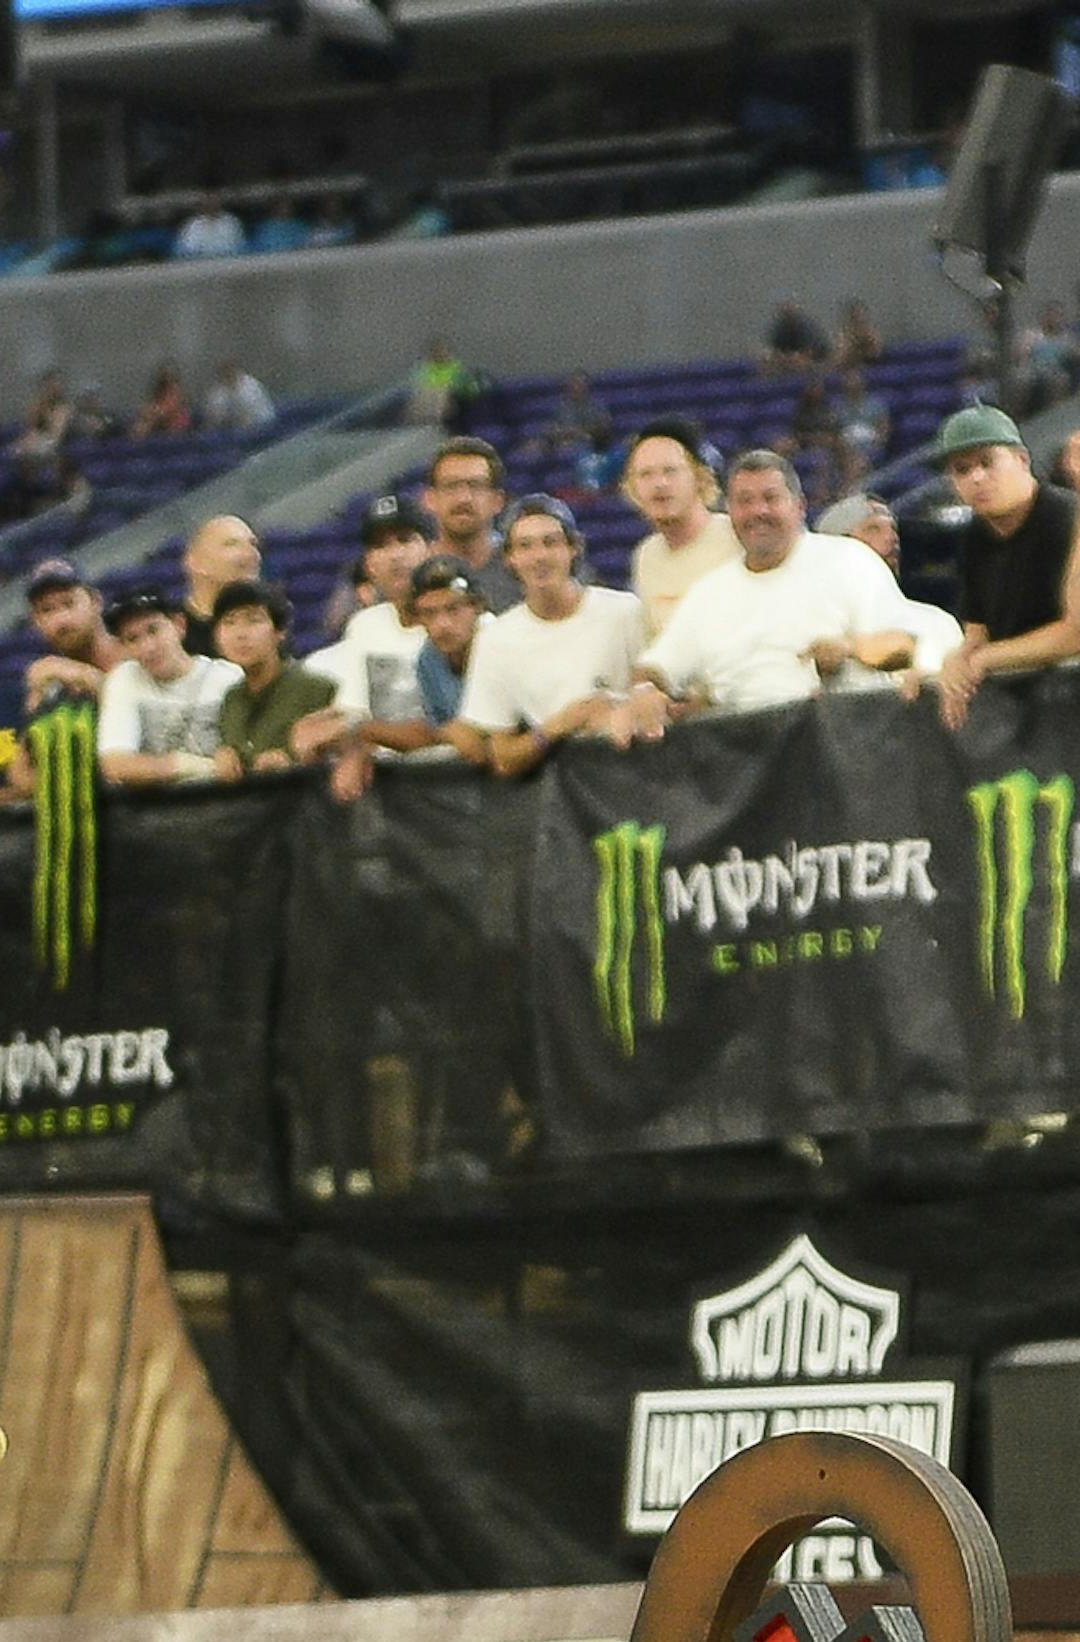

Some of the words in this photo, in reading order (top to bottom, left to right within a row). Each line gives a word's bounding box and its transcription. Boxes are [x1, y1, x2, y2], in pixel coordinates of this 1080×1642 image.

[663, 840, 938, 930] MONSTER
[712, 926, 883, 973] ENRGY
[718, 1266, 872, 1377] MOTOR
